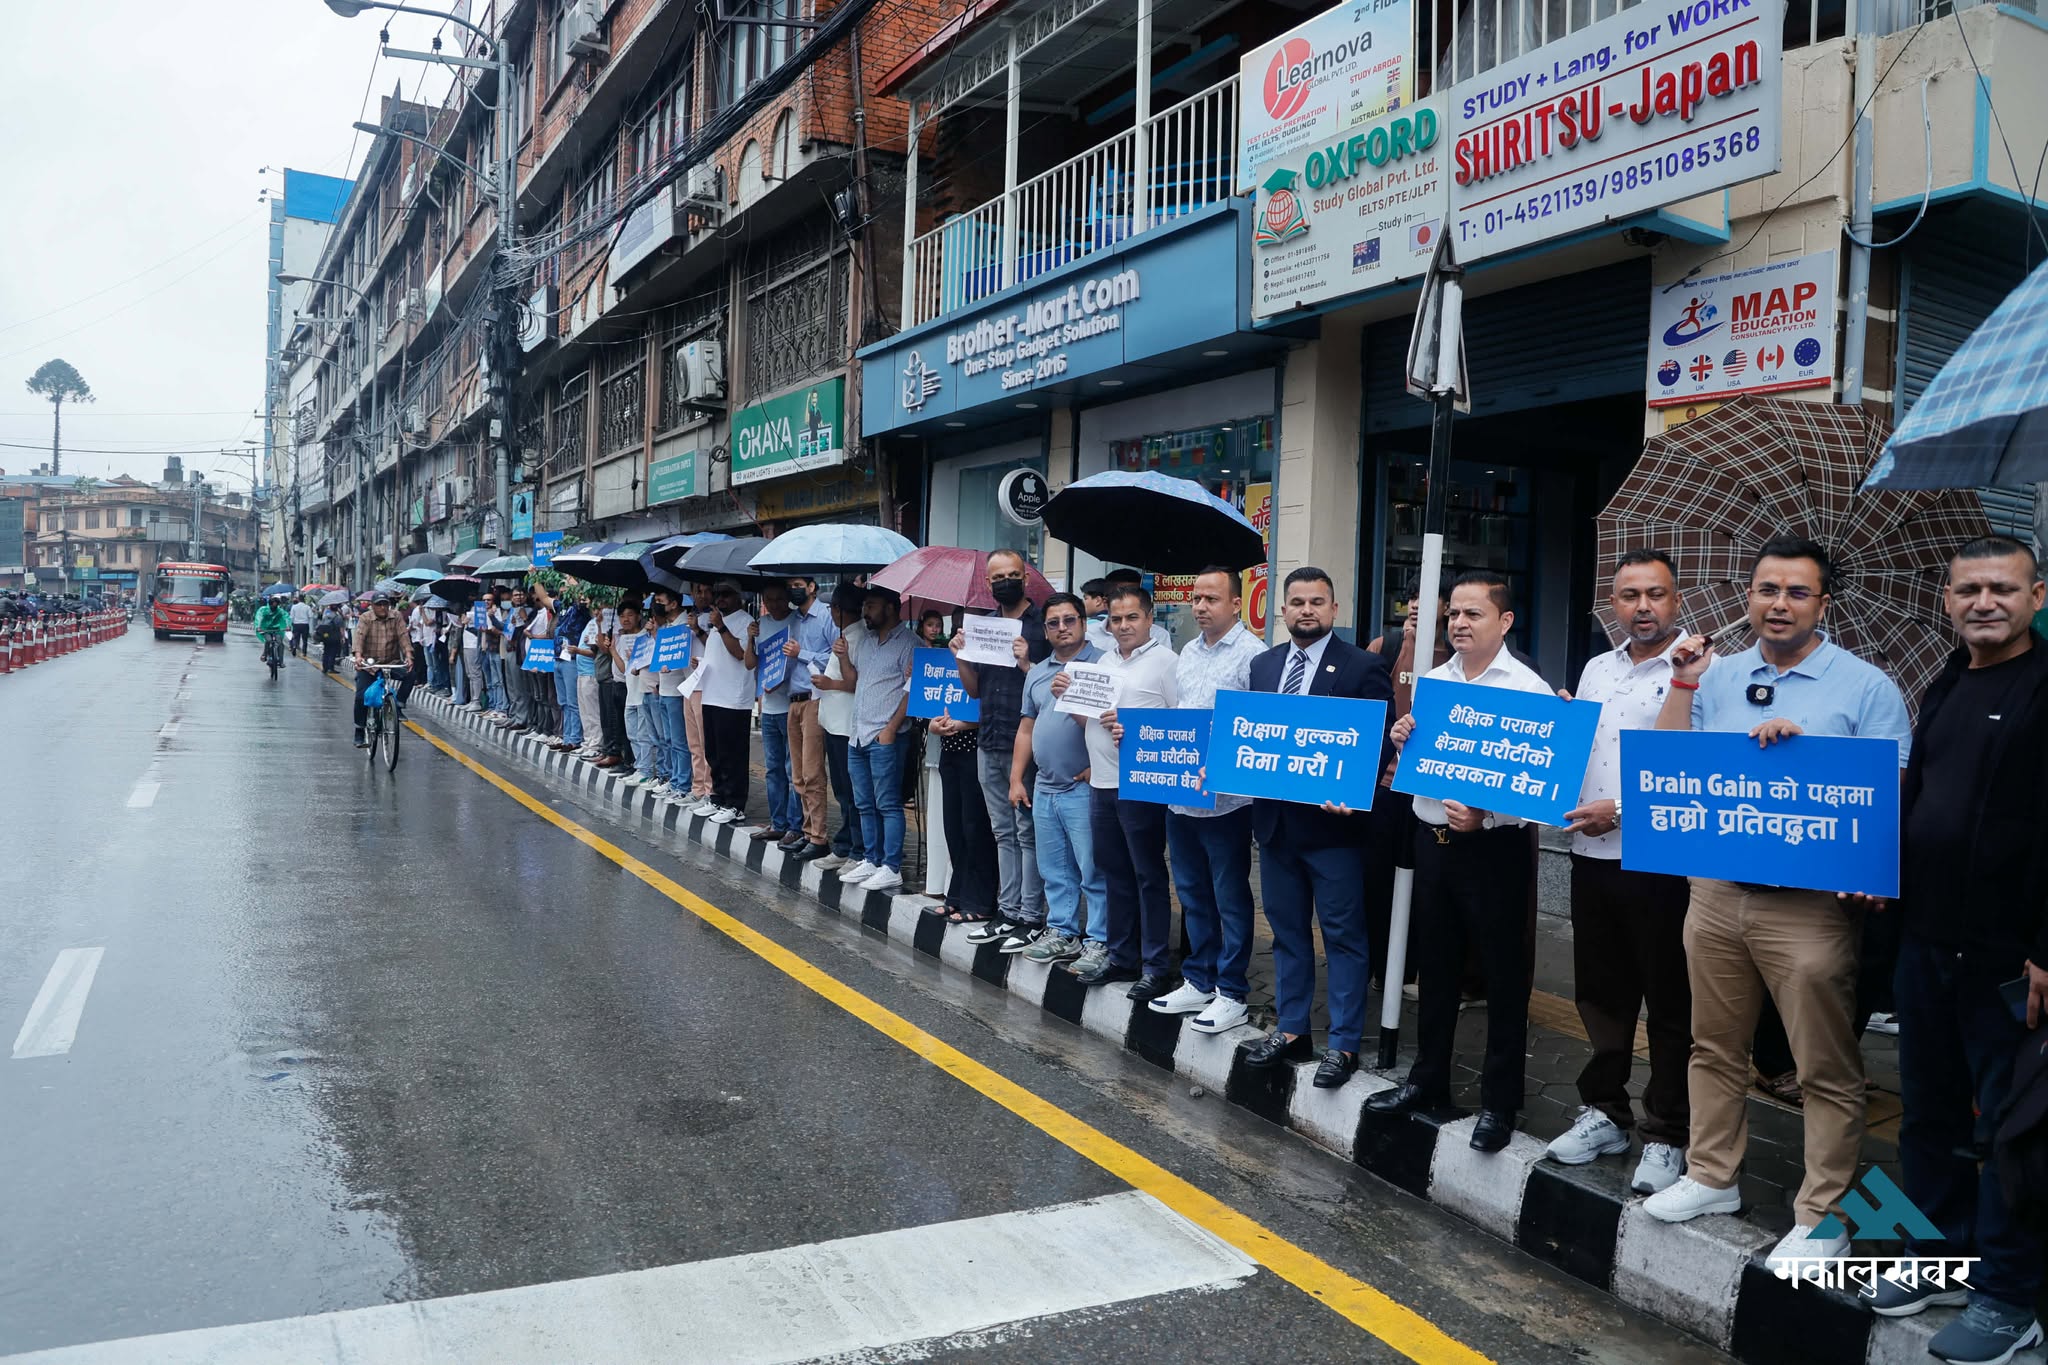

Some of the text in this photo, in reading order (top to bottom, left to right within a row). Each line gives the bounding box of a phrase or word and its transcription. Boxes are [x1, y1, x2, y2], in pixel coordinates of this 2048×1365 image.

[1354, 3, 1369, 23] 2nd
[1278, 31, 1372, 92] Learnova
[1350, 55, 1402, 84] STUDY ABROAD
[1307, 62, 1358, 90] GLOBAL PVT. LTD.
[1463, 73, 1532, 120] STUDY
[1537, 72, 1548, 88] +
[1554, 45, 1617, 83] Lang.
[1624, 24, 1661, 55] for
[1351, 88, 1360, 97] UK
[1351, 101, 1363, 112] USA
[1351, 106, 1385, 126] AUSTRALIA
[1247, 135, 1261, 145] TEST
[1263, 125, 1282, 137] CLASS
[1282, 118, 1316, 138] DUOLINGO
[1305, 108, 1439, 189] OXFORD
[1314, 157, 1439, 214] Study Global Pvt. Ltd.
[1459, 126, 1760, 242] T: 01-4521139/9851085368
[1359, 180, 1438, 217] IELTS/PTE/JLPT
[1378, 213, 1412, 231] Study in
[1415, 247, 1433, 257] JAPAN
[1352, 262, 1381, 275] AUSTRALIA
[1271, 279, 1286, 288] Nepal:
[1300, 280, 1327, 293] Kathmandu
[1731, 282, 1817, 322] MAP
[946, 269, 1140, 364] Brother-Mart.Com
[1731, 309, 1816, 334] EDUCATION
[1730, 321, 1816, 341] CONSULTANCY PVT. LTD.
[964, 313, 1119, 377] One Stop Gadget Solution
[1002, 353, 1067, 390] Since 2016
[1762, 374, 1777, 382] CAN
[1798, 370, 1814, 378] EUR
[1662, 388, 1675, 396] AUS
[1696, 384, 1705, 392] UK
[739, 416, 793, 461] OKAYA
[1018, 492, 1040, 503] Apple
[1154, 588, 1184, 600] आकर्षक
[924, 663, 960, 679] शिक्षा लगा
[924, 684, 943, 701] खर्च
[945, 684, 963, 704] हैन
[1448, 703, 1555, 739] शैक्षिक परामर्श
[1139, 725, 1196, 743] शैक्षिक परामर्श
[1232, 716, 1359, 748] शिक्षण शुल्कको
[1135, 746, 1199, 766] क्षेत्रमा धरौटीको
[1434, 731, 1555, 769] क्षेत्रमा धरौटीको
[1287, 752, 1329, 778] गरौं
[1129, 769, 1198, 789] आवश्यकता छैन
[1415, 758, 1506, 789] आवश्यकता
[1510, 772, 1547, 797] छैन
[1639, 770, 1875, 808] Brain Gain को पक्षमा
[1650, 800, 1708, 833] हाम्रो
